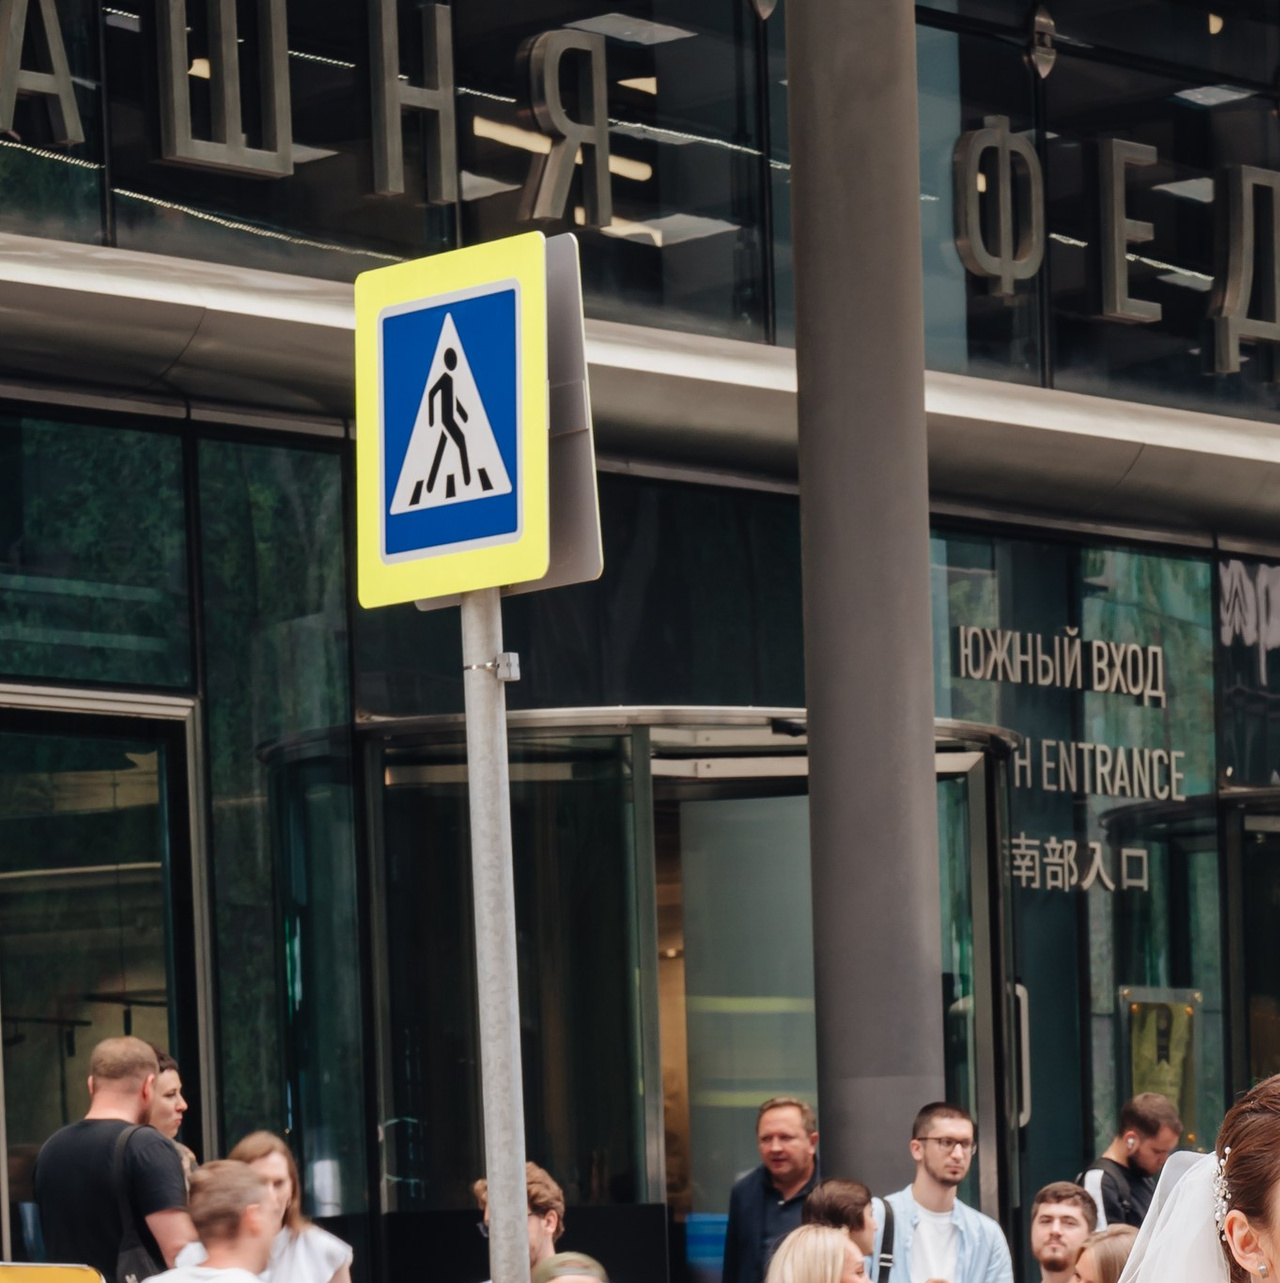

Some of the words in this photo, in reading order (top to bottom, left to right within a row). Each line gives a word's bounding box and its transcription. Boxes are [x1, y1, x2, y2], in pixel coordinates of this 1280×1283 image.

[959, 625, 1082, 689] ЮЖНЫЙ
[1091, 639, 1167, 709] ВХОД
[1041, 739, 1187, 801] ENTRANCE
[1011, 831, 1149, 893] 南部入口
